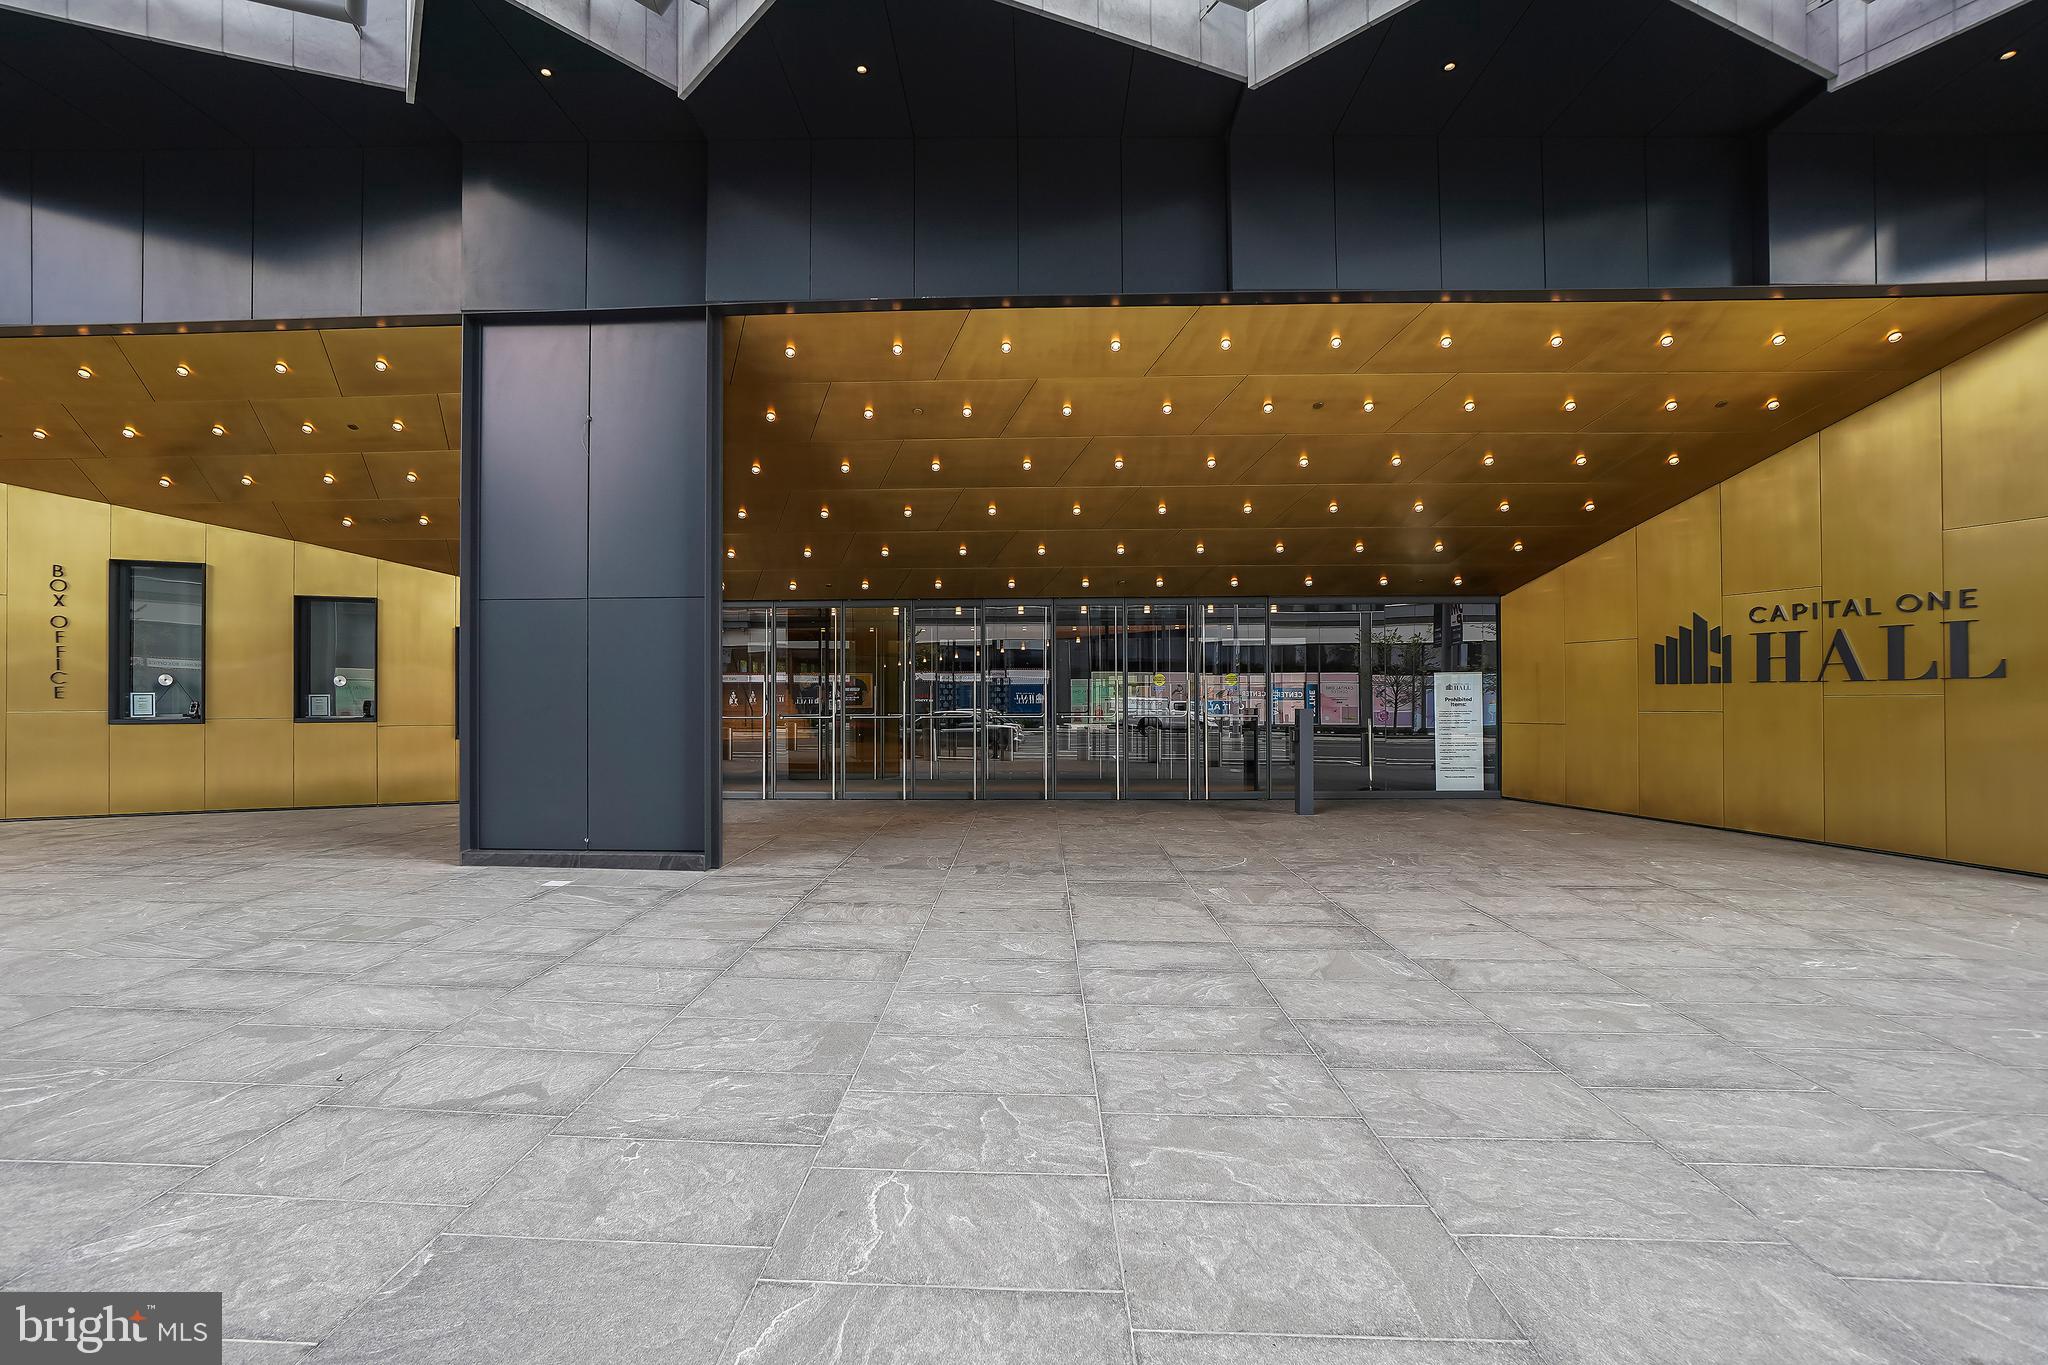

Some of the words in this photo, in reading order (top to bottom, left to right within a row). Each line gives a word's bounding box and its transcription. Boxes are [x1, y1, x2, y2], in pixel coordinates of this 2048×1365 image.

[49, 564, 68, 607] BOX
[1749, 597, 1882, 624] CAPITAL
[1896, 588, 1979, 614] ONE
[49, 614, 69, 699] OFFICE
[1749, 619, 2007, 683] HALL
